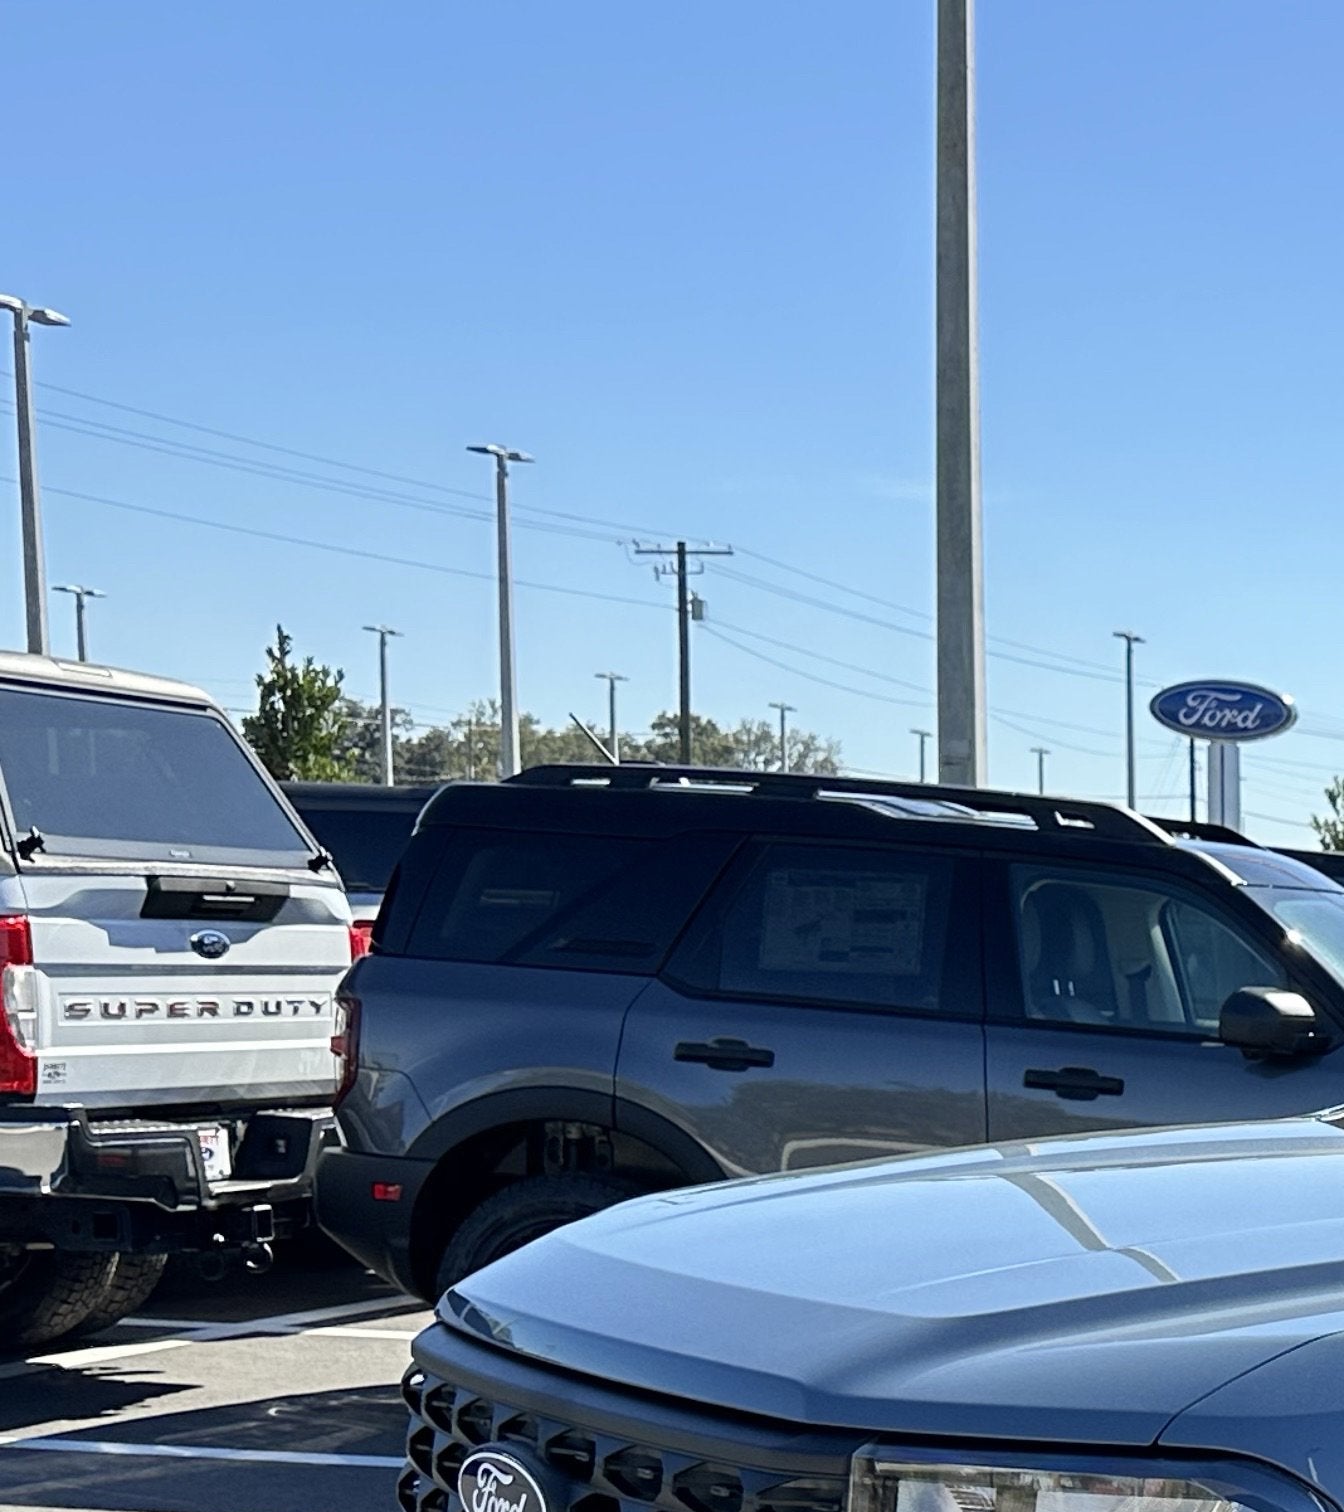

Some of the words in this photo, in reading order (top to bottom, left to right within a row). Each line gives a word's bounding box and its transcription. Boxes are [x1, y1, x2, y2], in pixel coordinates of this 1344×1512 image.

[1178, 690, 1263, 729] Ford
[64, 1000, 221, 1020] SUPER
[232, 999, 329, 1015] DUTY
